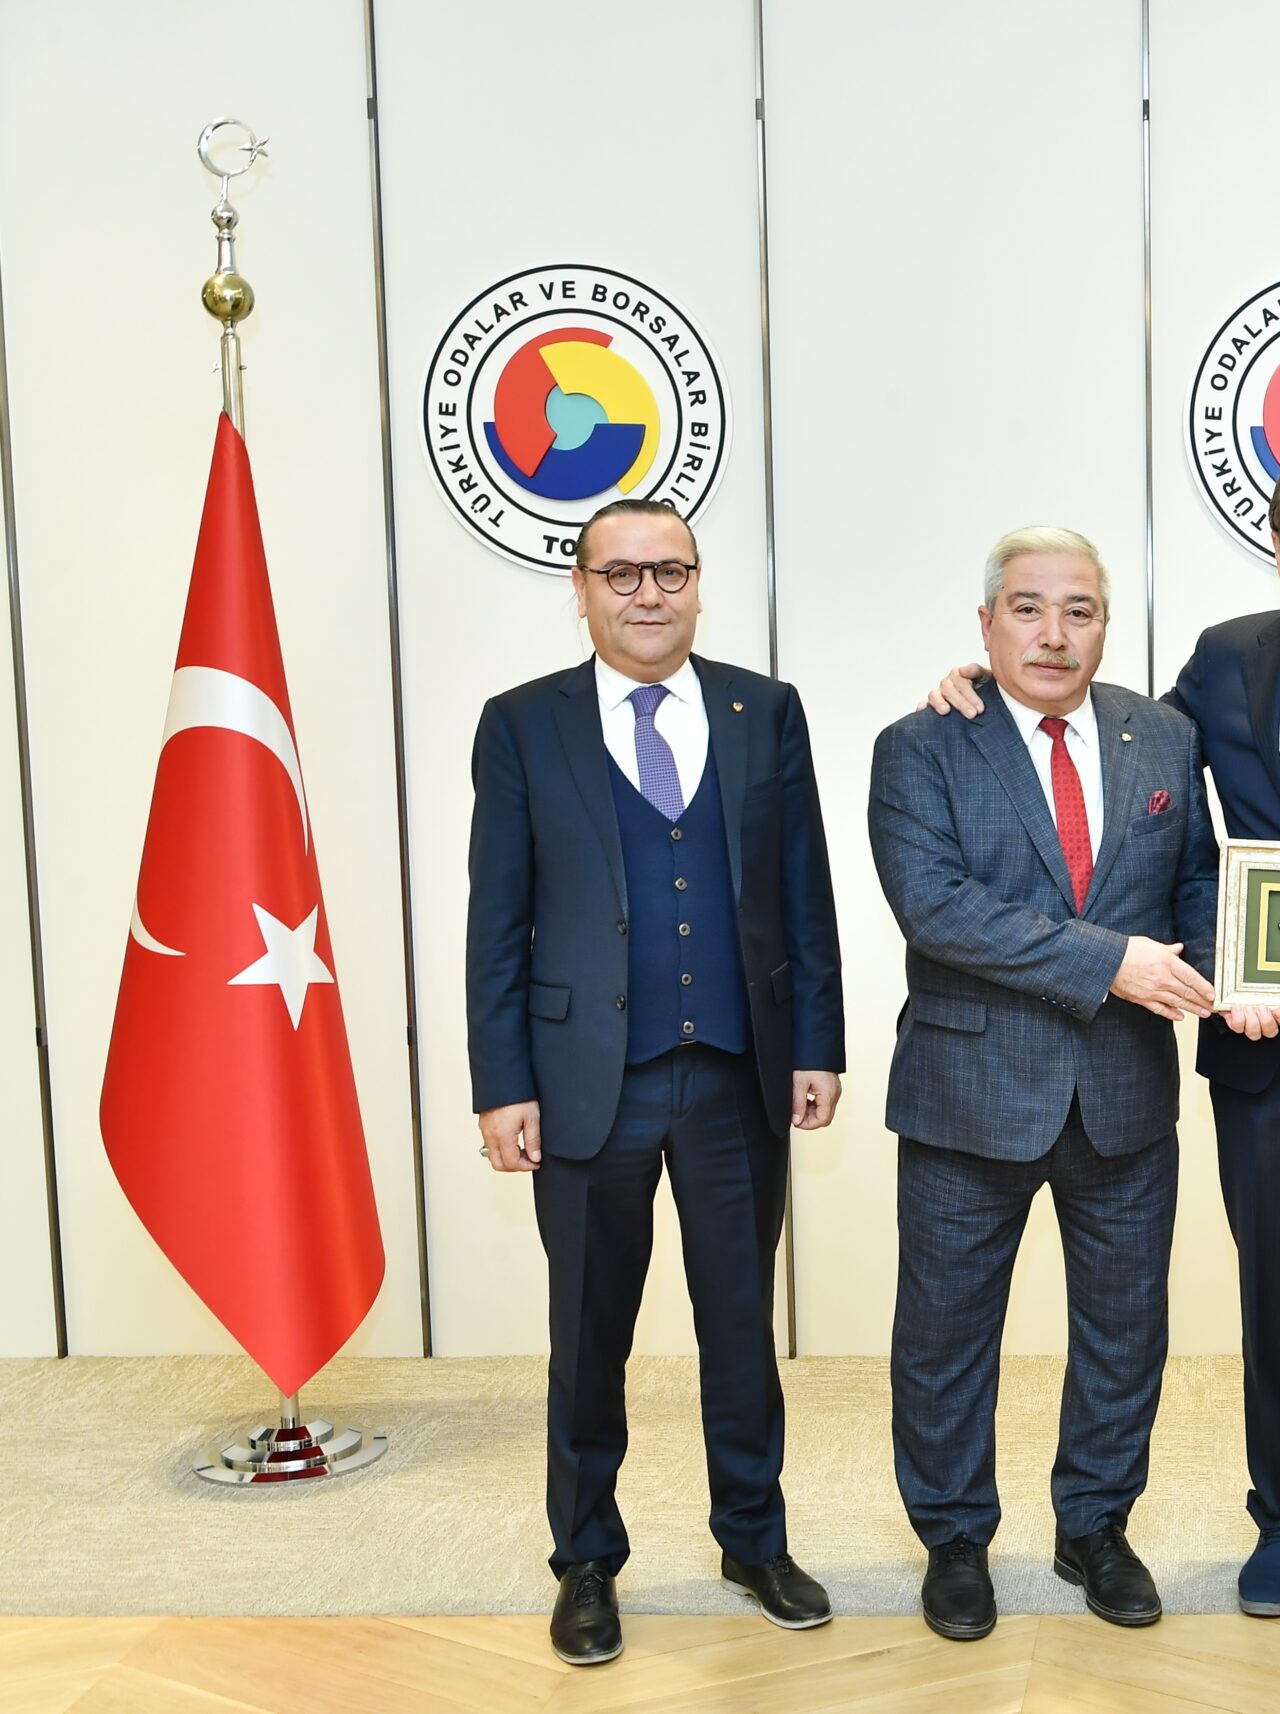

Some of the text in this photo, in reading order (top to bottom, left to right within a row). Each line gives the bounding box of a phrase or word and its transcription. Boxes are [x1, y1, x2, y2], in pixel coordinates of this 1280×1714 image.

[439, 281, 711, 528] TÜRKİYE ODALAR VE BORSALAR BİRLİ
[1204, 406, 1267, 531] TÜRKİYE
[543, 535, 577, 557] TO
